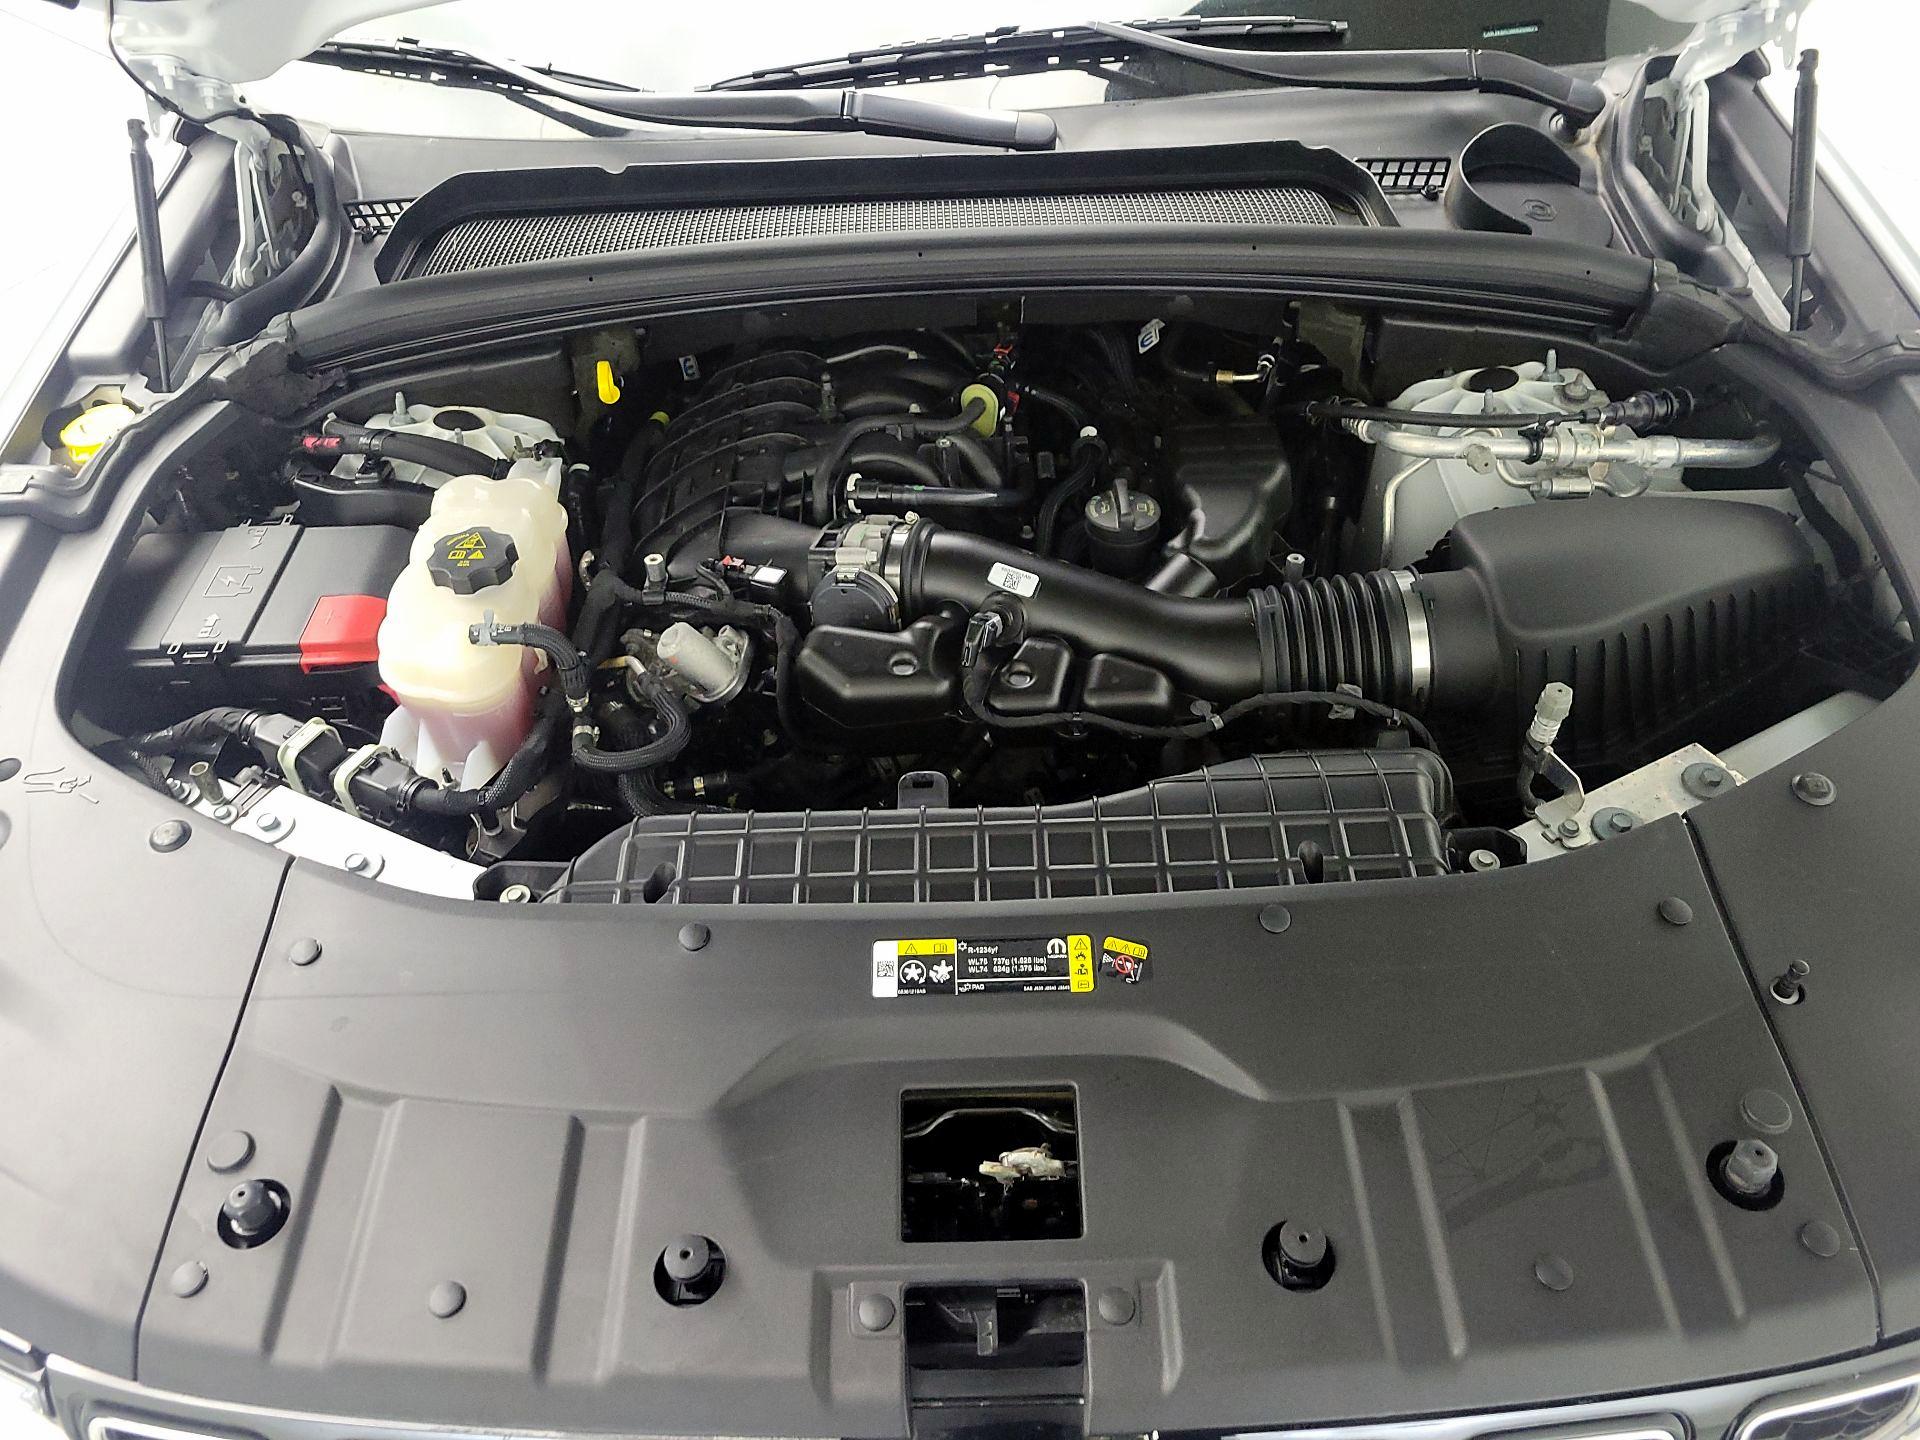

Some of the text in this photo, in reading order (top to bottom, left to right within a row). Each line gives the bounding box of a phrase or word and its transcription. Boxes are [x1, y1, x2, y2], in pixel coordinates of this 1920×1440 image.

[967, 945, 999, 954] R-1234yf
[992, 957, 1010, 966] 737g
[1033, 956, 1047, 965] lbs)
[968, 965, 988, 973] WL74
[1034, 964, 1047, 973] lbs)
